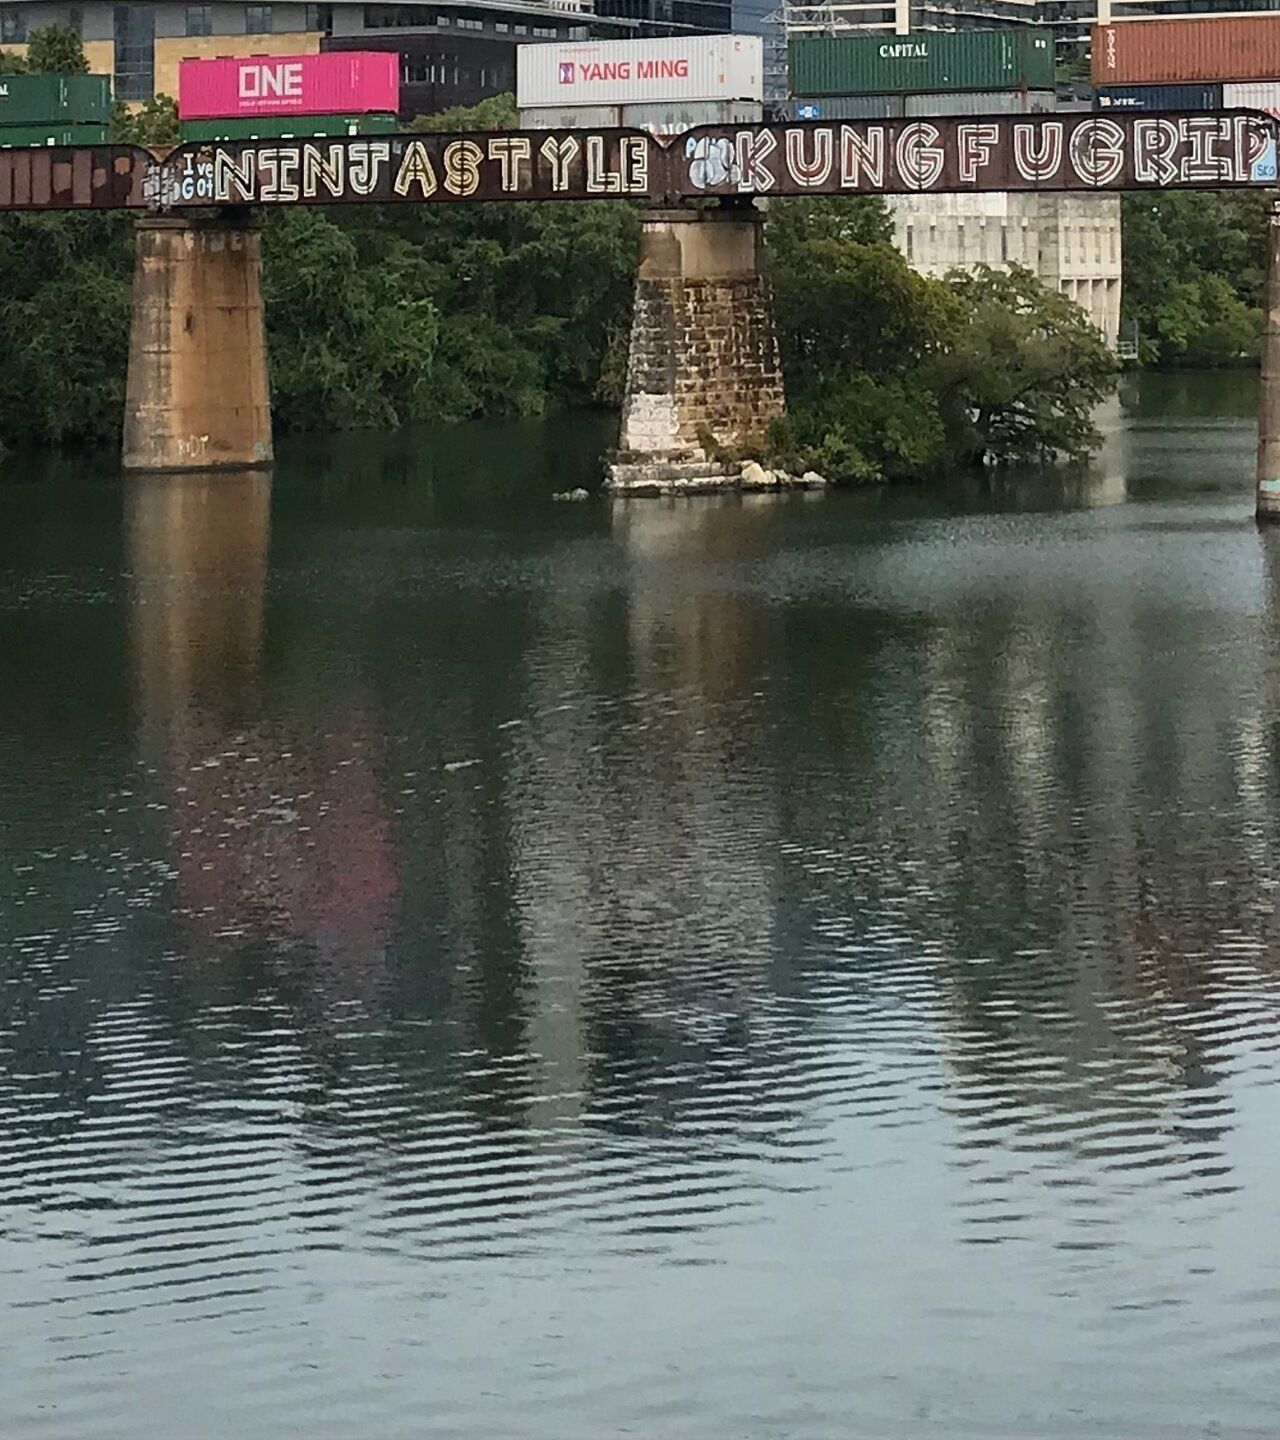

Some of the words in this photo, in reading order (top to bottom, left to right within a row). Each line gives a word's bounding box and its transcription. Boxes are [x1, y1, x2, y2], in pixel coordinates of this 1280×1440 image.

[879, 42, 929, 58] CAPITAL
[238, 62, 303, 98] ONE
[579, 60, 630, 82] YANG
[636, 59, 689, 80] MING
[1069, 115, 1272, 187] GRIP
